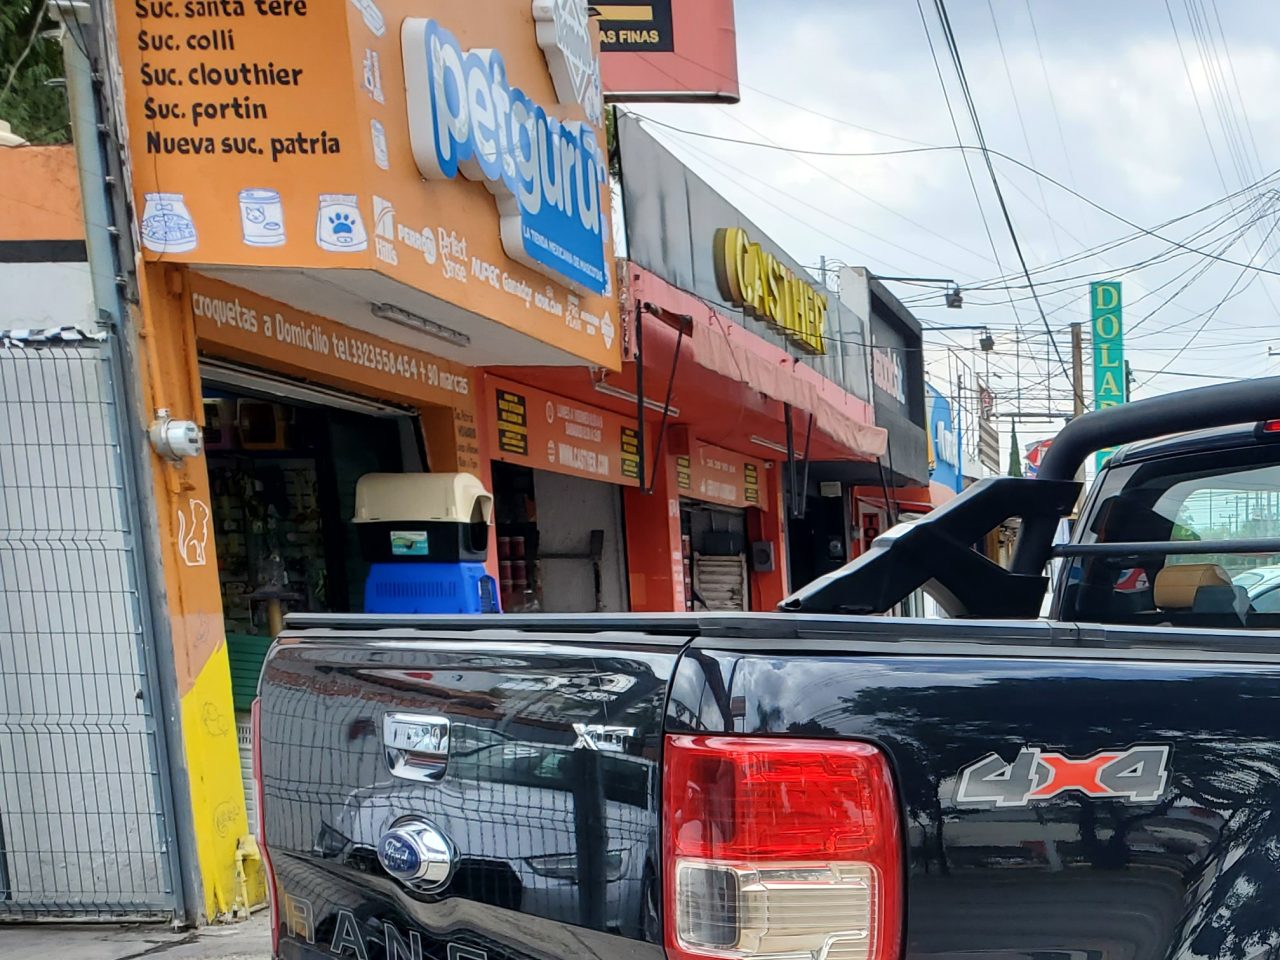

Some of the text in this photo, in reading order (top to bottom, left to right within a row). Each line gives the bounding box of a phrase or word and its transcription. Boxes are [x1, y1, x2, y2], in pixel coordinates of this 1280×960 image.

[135, 0, 307, 19] Suc. santa tere
[138, 30, 180, 51] Suc.
[619, 30, 660, 43] FINAS
[140, 62, 303, 86] Suc. clouthier
[144, 96, 267, 127] Suc. fortin
[146, 131, 340, 162] Nueva suc. patria
[192, 293, 258, 333] croquetas
[263, 314, 272, 337] a
[275, 314, 329, 355] Domicilio
[427, 364, 439, 386] 90
[440, 371, 469, 394] marcas
[1095, 285, 1123, 412] DOLA
[572, 723, 638, 752] XLT
